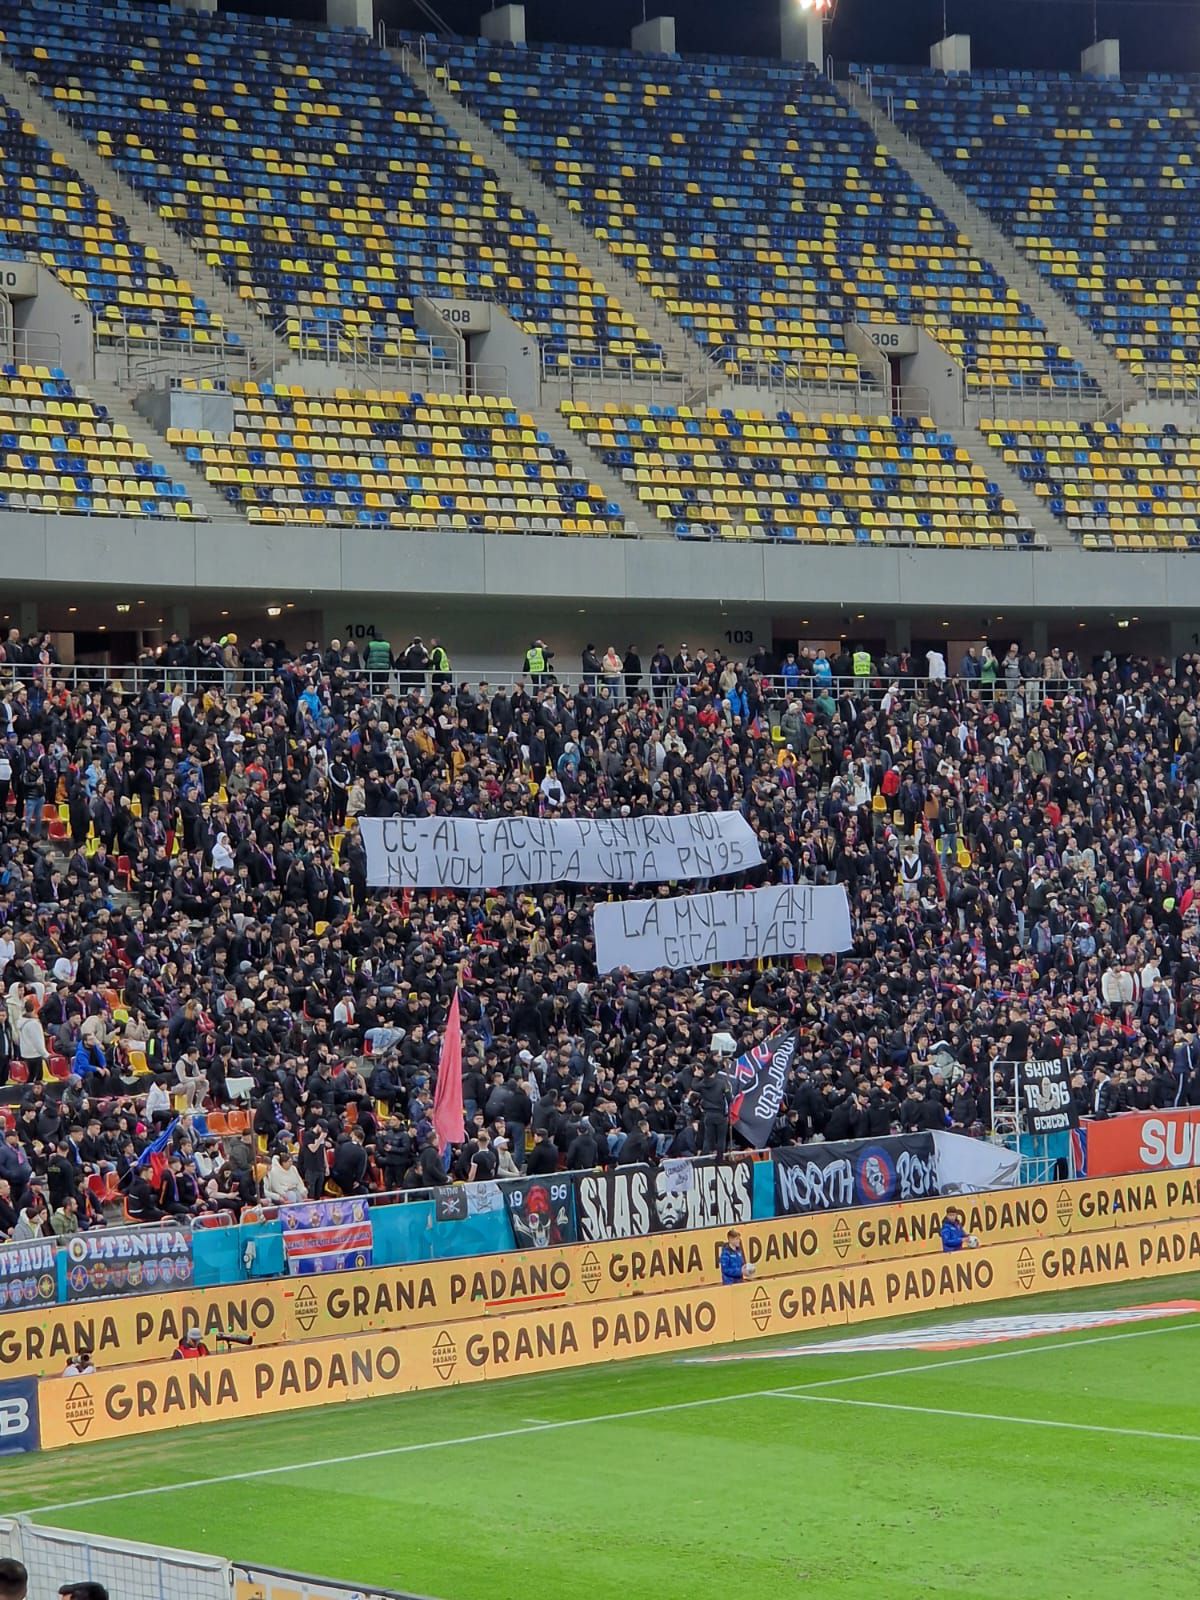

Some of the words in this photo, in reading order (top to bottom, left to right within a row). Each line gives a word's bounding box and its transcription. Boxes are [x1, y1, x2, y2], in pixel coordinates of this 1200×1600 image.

[442, 308, 470, 322] 308
[871, 333, 899, 346] 306
[345, 624, 376, 639] 104
[724, 629, 753, 644] 103
[382, 819, 458, 853] CE-AI
[575, 815, 676, 848] PENTRU
[688, 813, 723, 842] NOI
[434, 854, 484, 886] VOM
[621, 902, 660, 938] LA
[673, 891, 759, 934] MULTI
[773, 886, 814, 920] ANI
[664, 930, 719, 967] GICA
[743, 920, 808, 957] HAGI
[1024, 1059, 1062, 1078] SKINS
[509, 1190, 523, 1207] 19
[550, 1184, 568, 1201] 96
[778, 1158, 855, 1210] NORTH
[1079, 1184, 1157, 1218] GRANA
[68, 1231, 189, 1263] OLTENITA
[857, 1212, 942, 1248] GRANA
[608, 1244, 703, 1282] GRANA
[1041, 1241, 1129, 1279] GRANA
[326, 1277, 437, 1319] GRANA
[450, 1261, 571, 1304] PADANO
[779, 1277, 875, 1319] GRANA
[886, 1259, 994, 1304] PADANO
[0, 1315, 121, 1364] GRANA
[432, 1347, 457, 1356] GRANA
[465, 1320, 579, 1367] GRANA
[592, 1301, 716, 1349] PADANO
[432, 1355, 458, 1364] PADANO
[105, 1368, 239, 1421] GRANA
[255, 1345, 401, 1399] PADANO
[65, 1400, 94, 1410] GRANA
